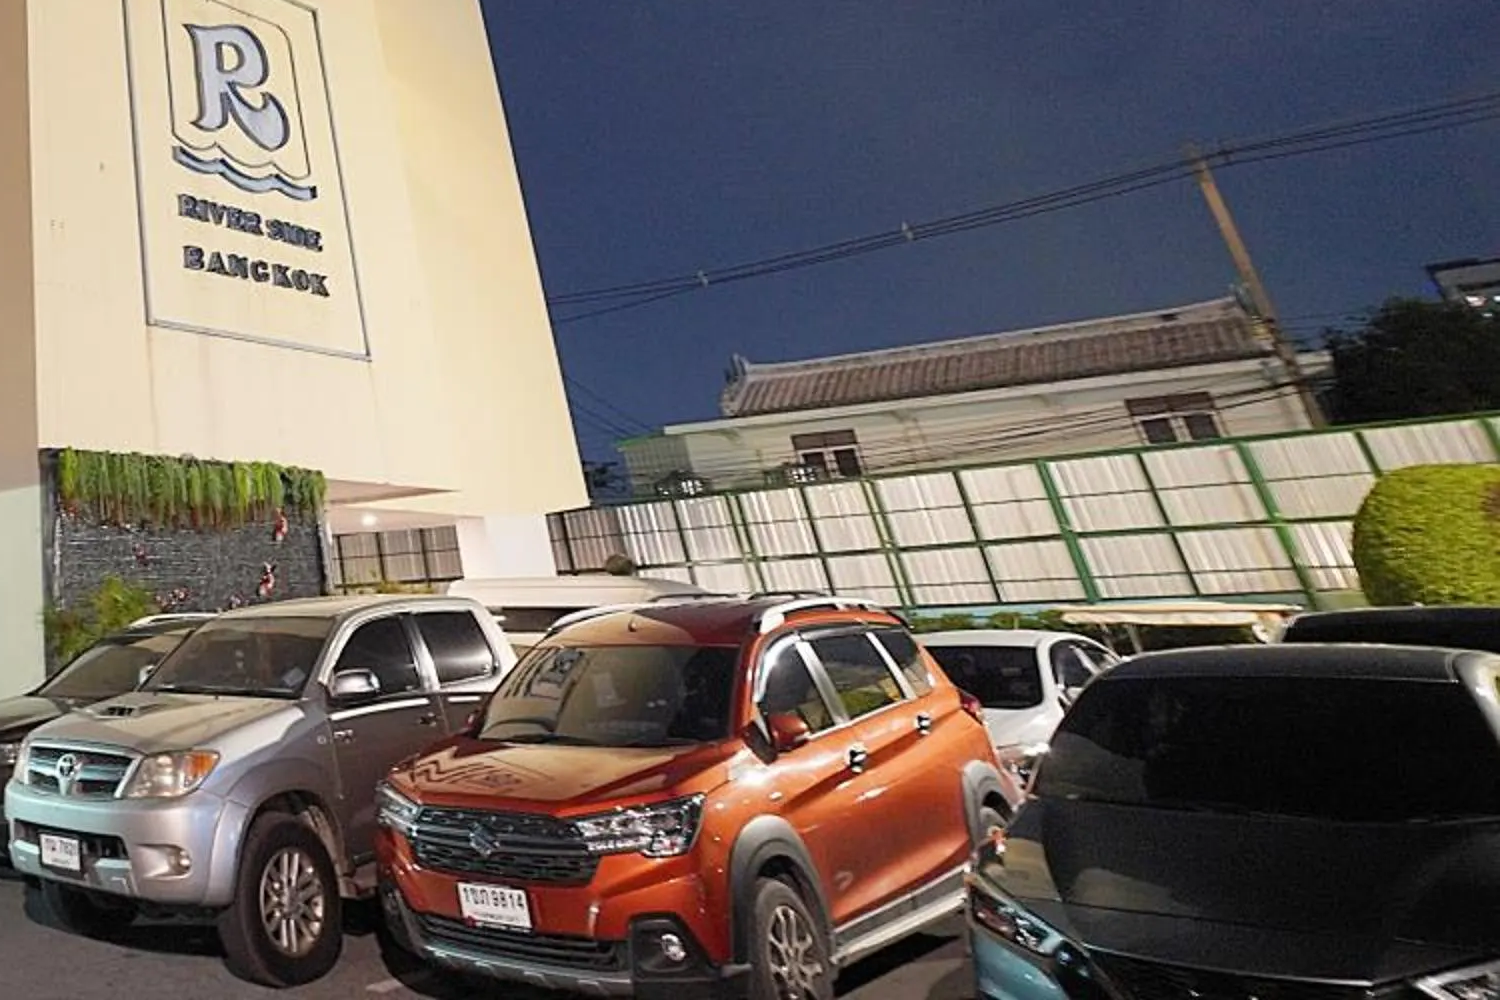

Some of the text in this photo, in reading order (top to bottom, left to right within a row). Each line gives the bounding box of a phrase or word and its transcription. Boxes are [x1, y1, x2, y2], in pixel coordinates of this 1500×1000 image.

[182, 22, 291, 151] R
[177, 193, 265, 236] RIVER
[182, 245, 331, 298] BANGKOK
